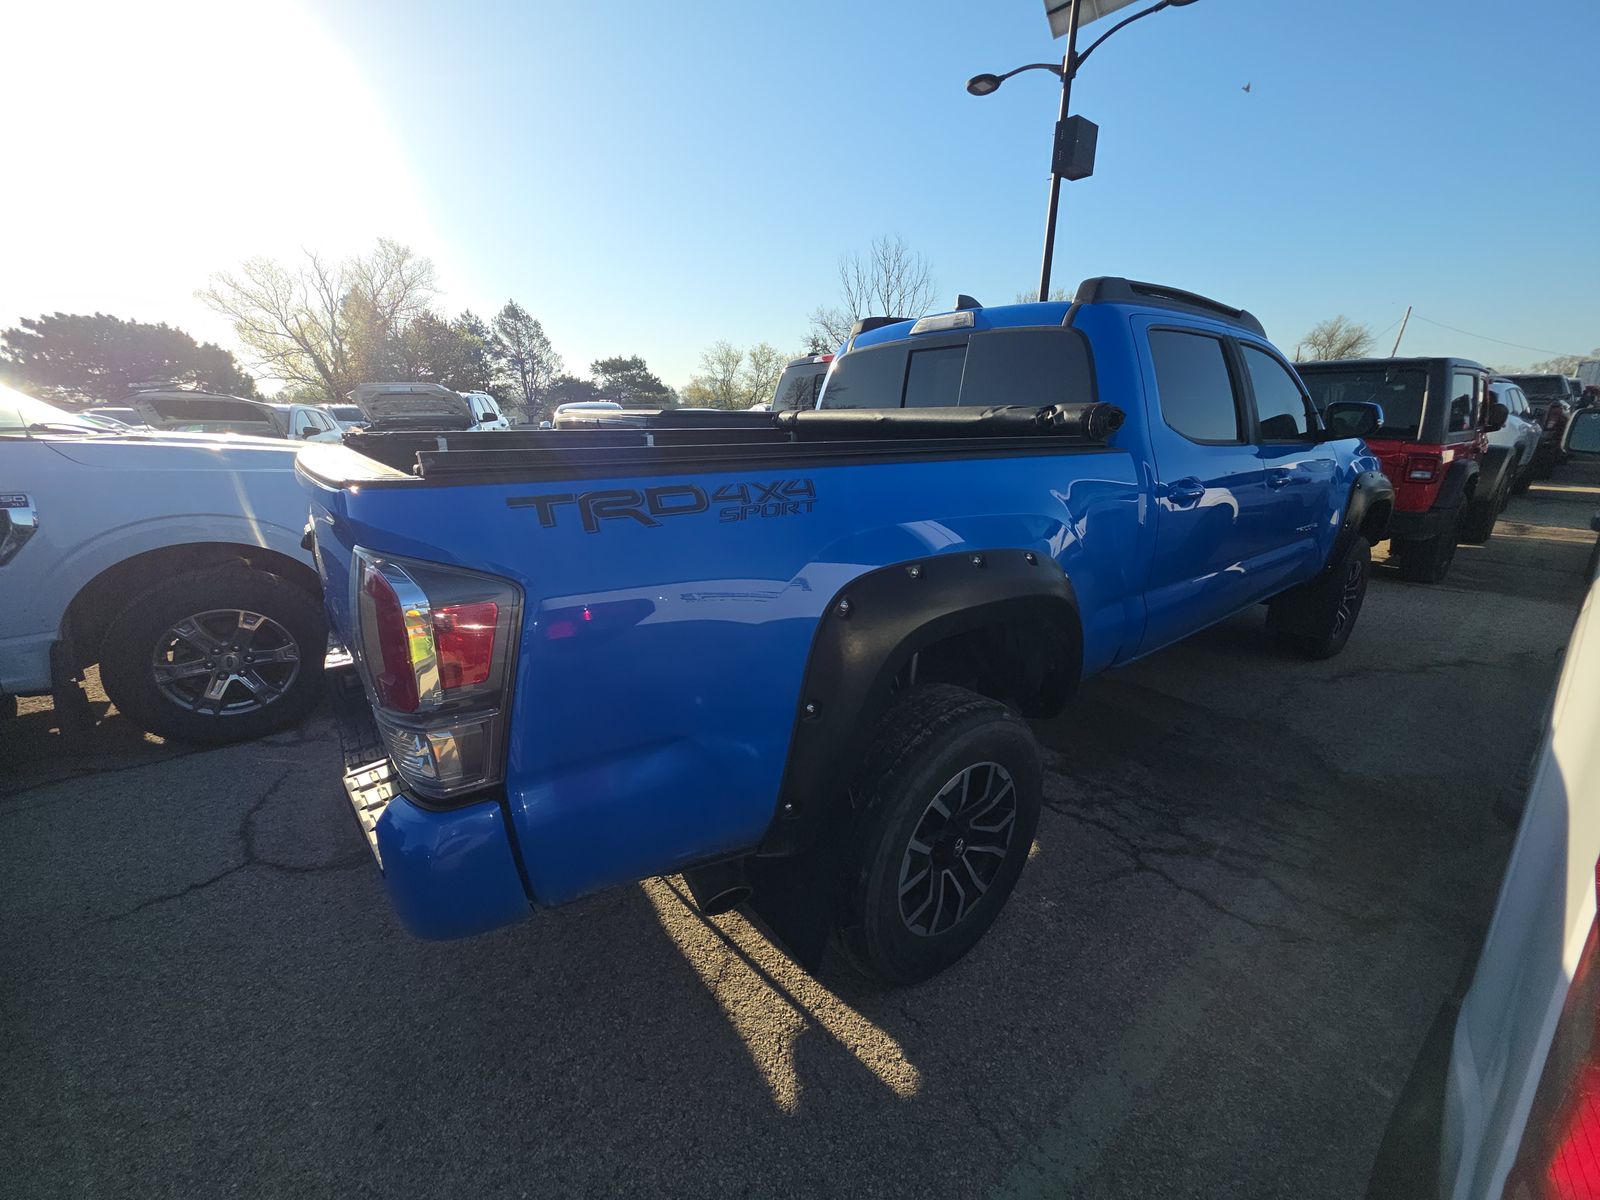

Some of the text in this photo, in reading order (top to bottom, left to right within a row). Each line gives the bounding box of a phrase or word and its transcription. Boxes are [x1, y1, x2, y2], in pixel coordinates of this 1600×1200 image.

[506, 479, 816, 534] TRD 4X4
[719, 499, 818, 523] SPORT
